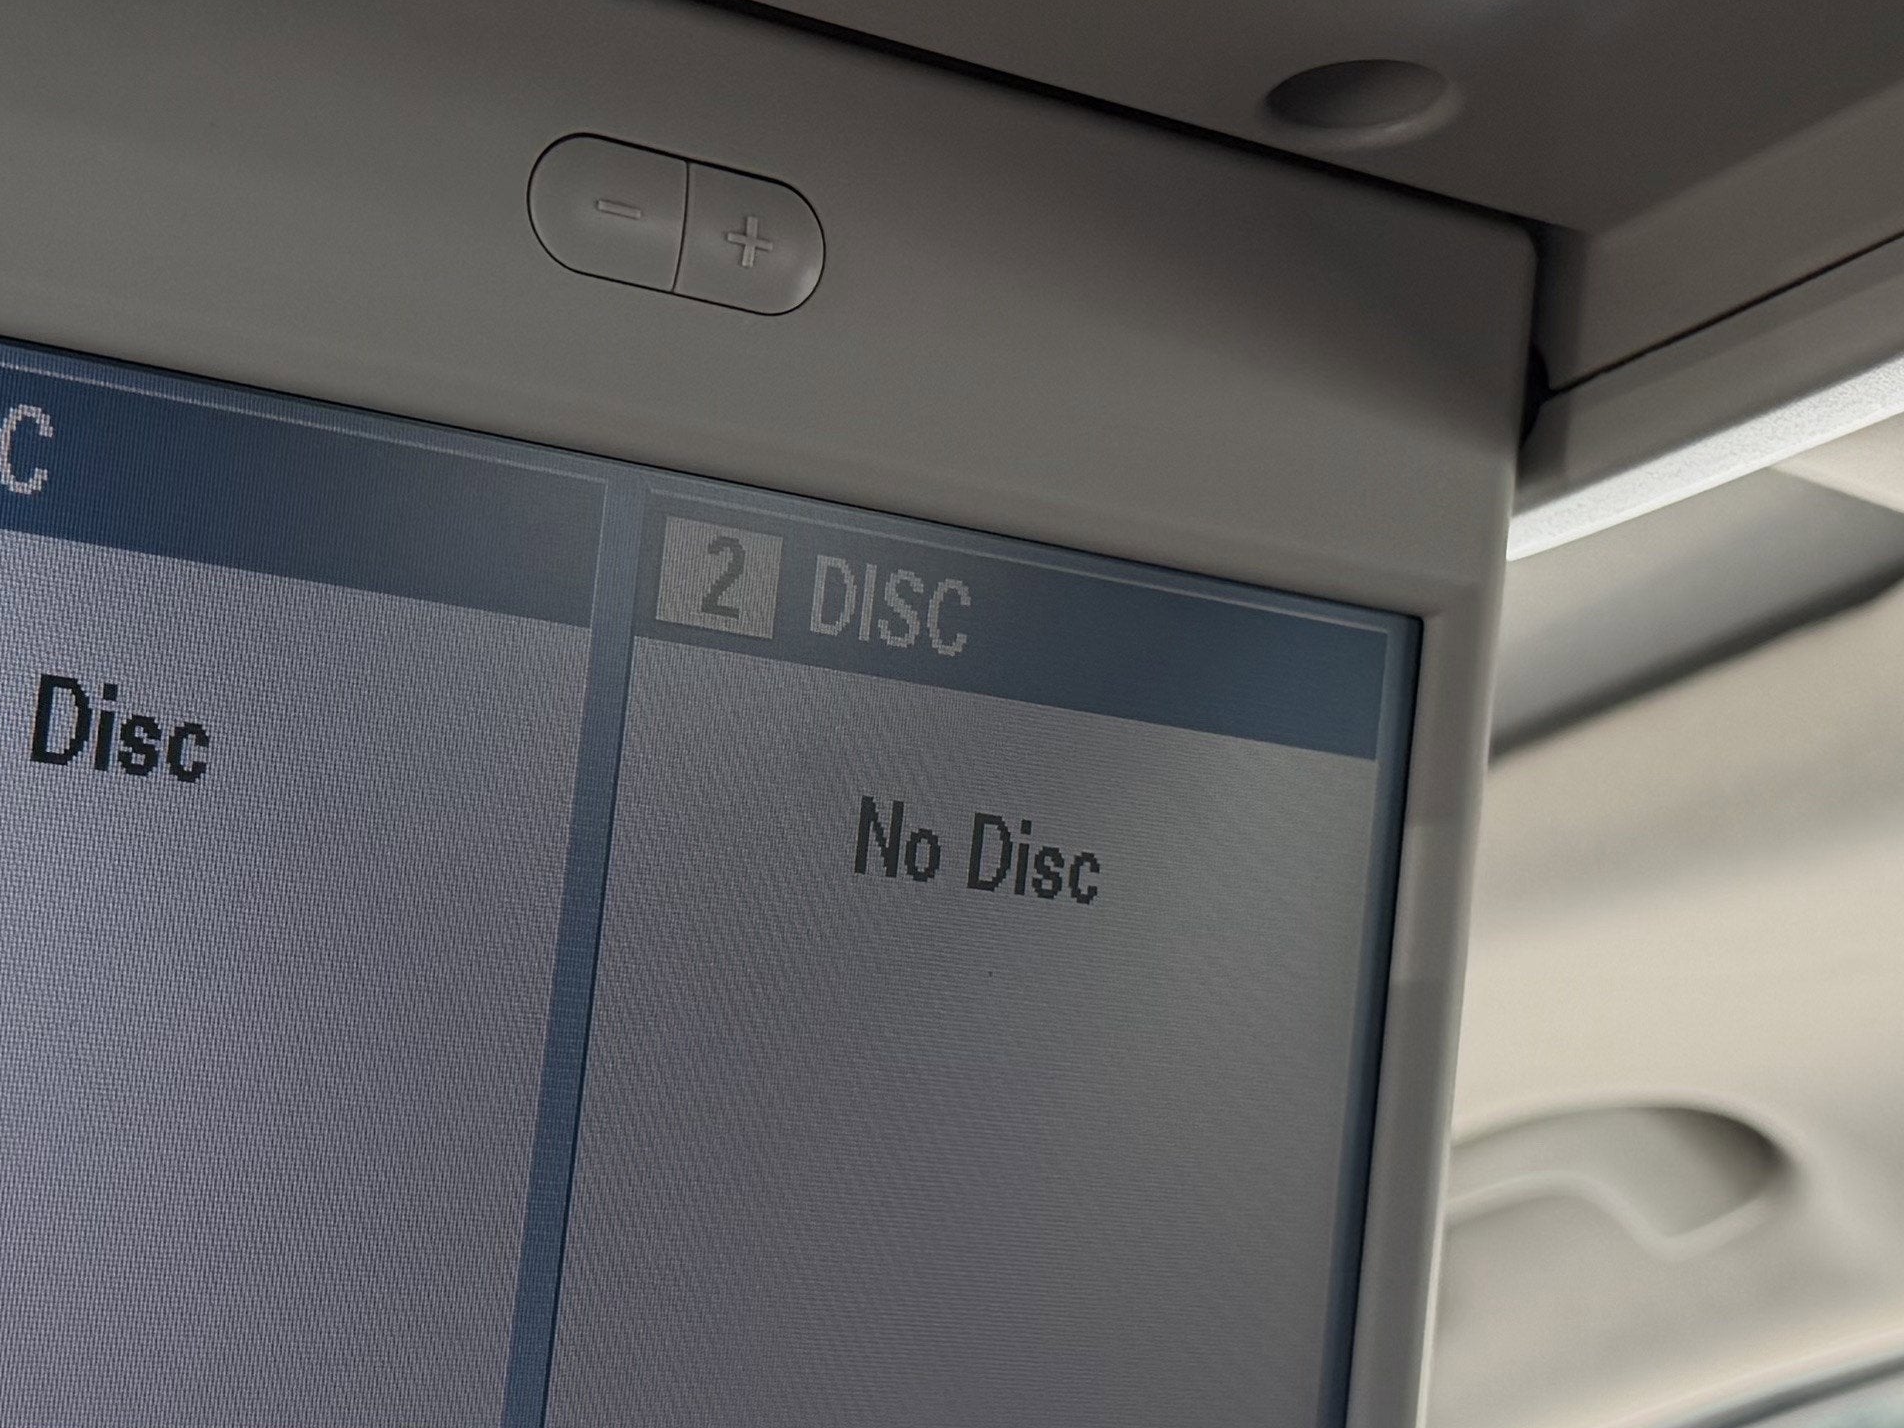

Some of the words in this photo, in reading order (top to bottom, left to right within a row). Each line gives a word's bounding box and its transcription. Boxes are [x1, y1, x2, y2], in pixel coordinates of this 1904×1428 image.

[700, 535, 747, 620] 2
[809, 554, 972, 657] DISC
[30, 673, 211, 783] Disc
[854, 795, 941, 882] No
[967, 812, 1101, 904] Disc
